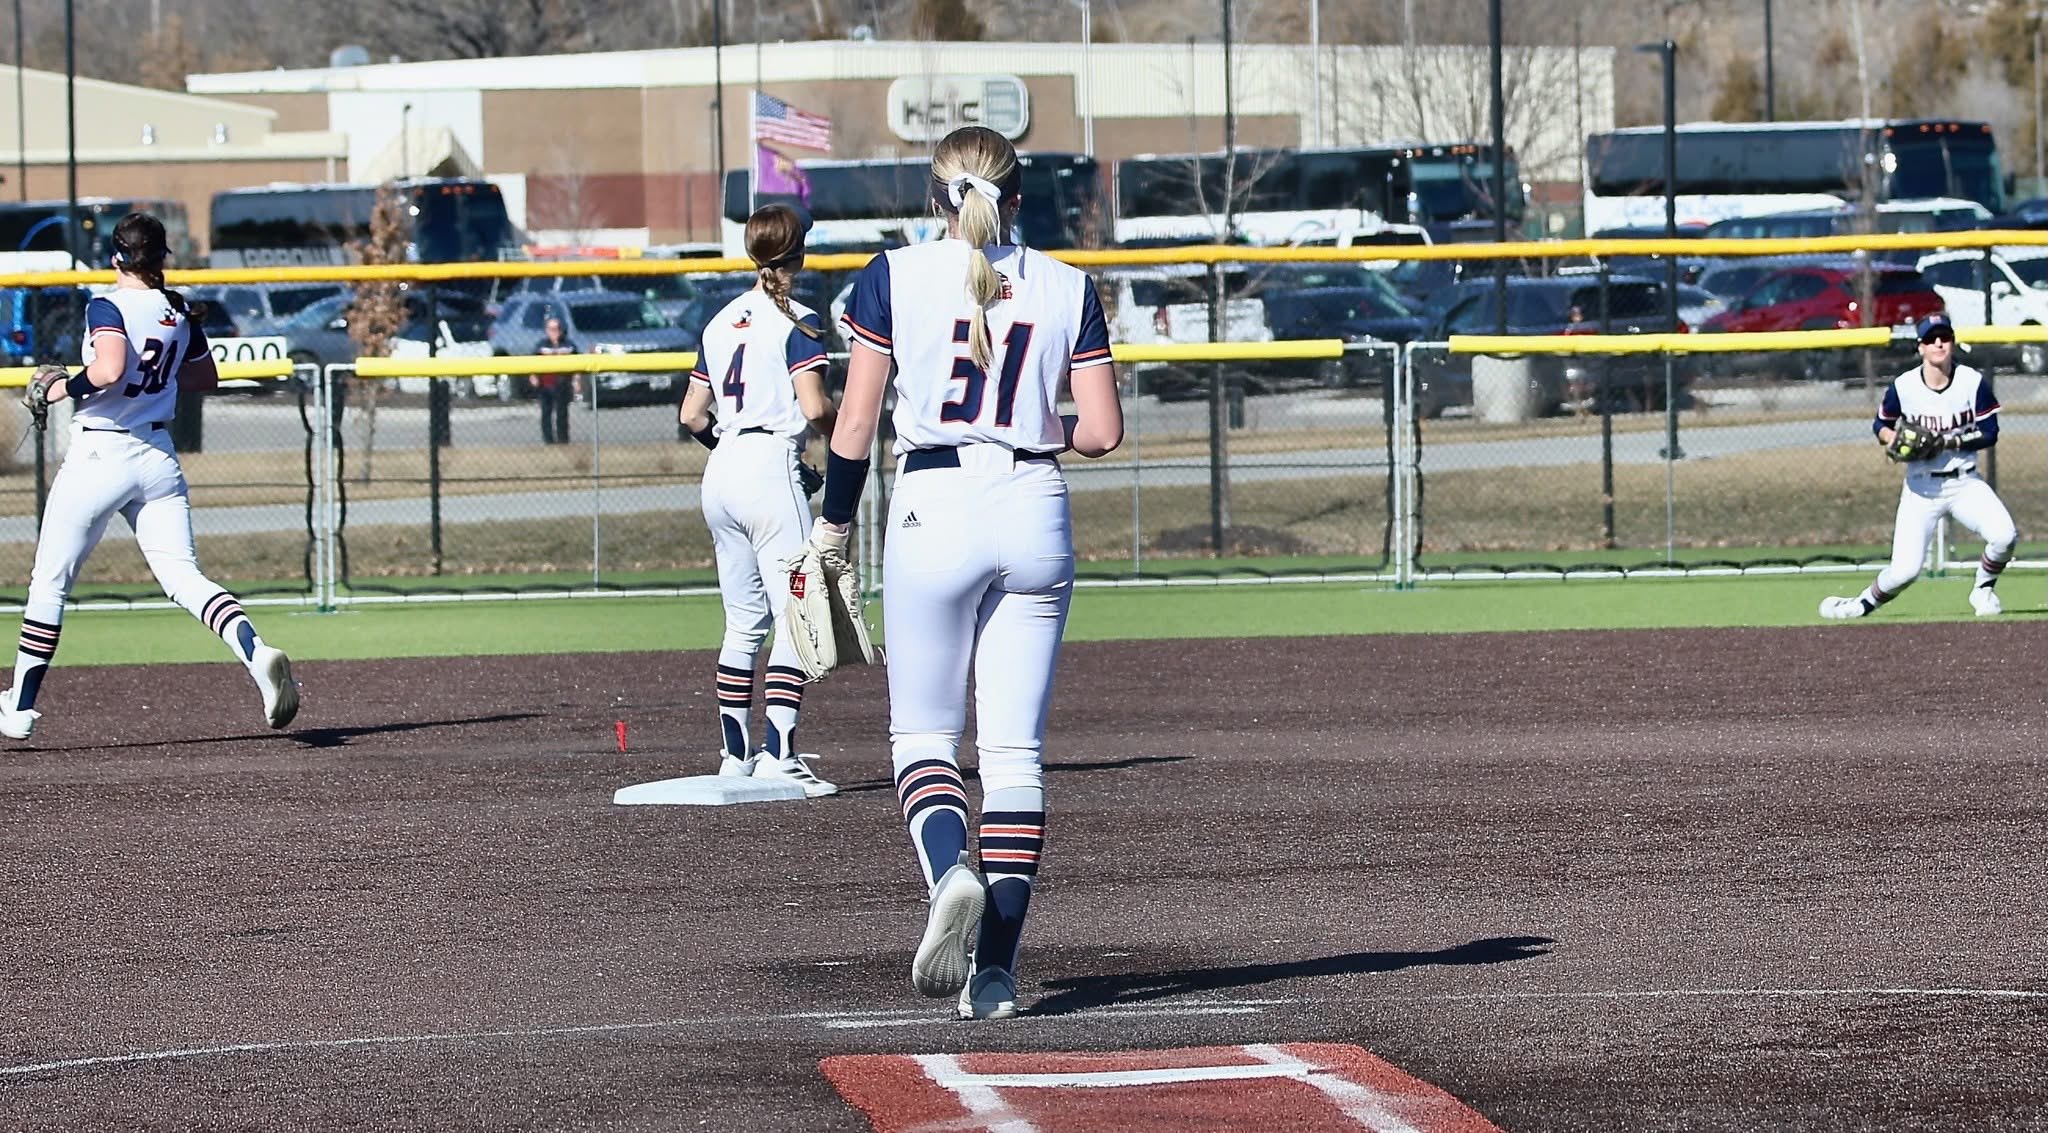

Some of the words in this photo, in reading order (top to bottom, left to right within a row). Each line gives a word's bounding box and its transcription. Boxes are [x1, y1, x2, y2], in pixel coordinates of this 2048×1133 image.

[122, 337, 179, 398] 30
[722, 343, 746, 414] 4
[941, 319, 1035, 427] 31
